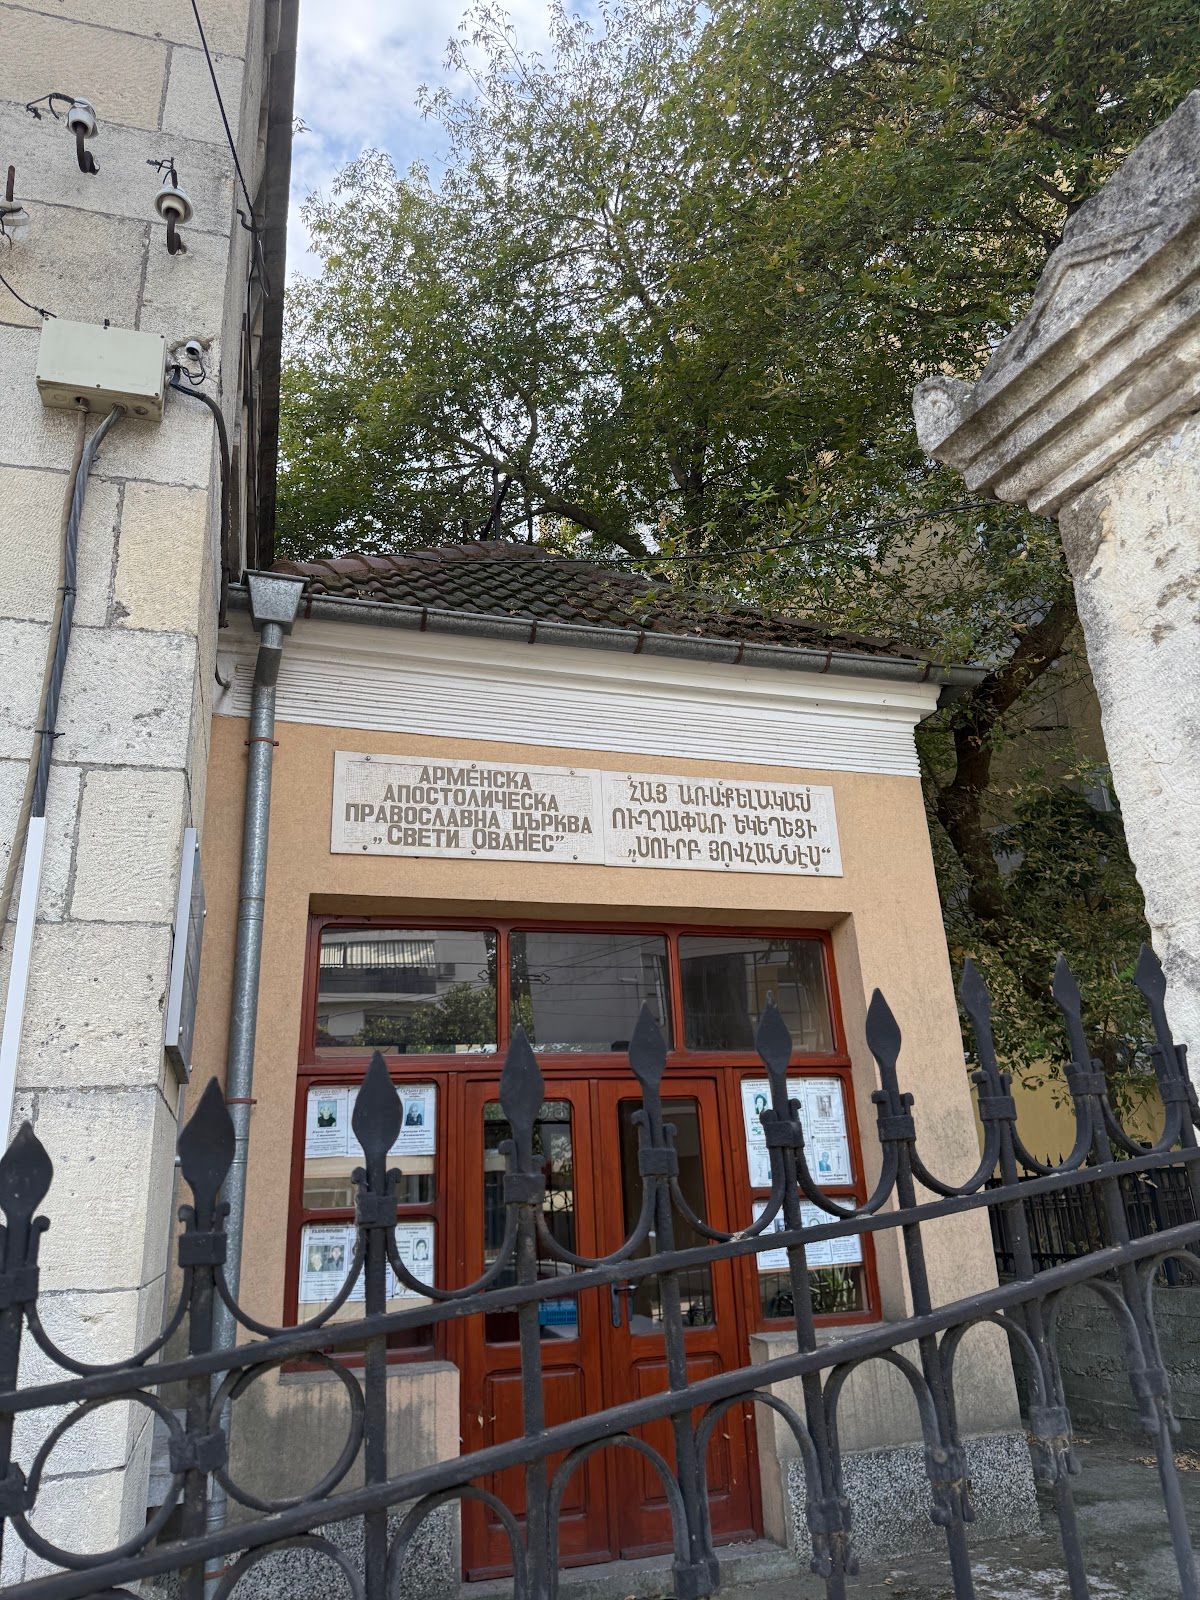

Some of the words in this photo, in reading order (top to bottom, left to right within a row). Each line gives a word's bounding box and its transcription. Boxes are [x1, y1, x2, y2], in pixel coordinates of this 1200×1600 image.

[419, 766, 532, 790] АРМЕНСКА
[383, 784, 559, 812] АПОСТОЛИЧЕСКА
[629, 781, 667, 805] ՀԱՅ
[678, 784, 812, 812] ԱՌԱՔԵԼԱԿԱՆ
[345, 803, 500, 829] ПРАВОСЛАВНА
[512, 811, 592, 834] ЦЪРКВА
[612, 807, 727, 834] ՈՒՂՂԱՓԱՌ
[733, 814, 818, 839] ԵԿԵՂԵՑԻ
